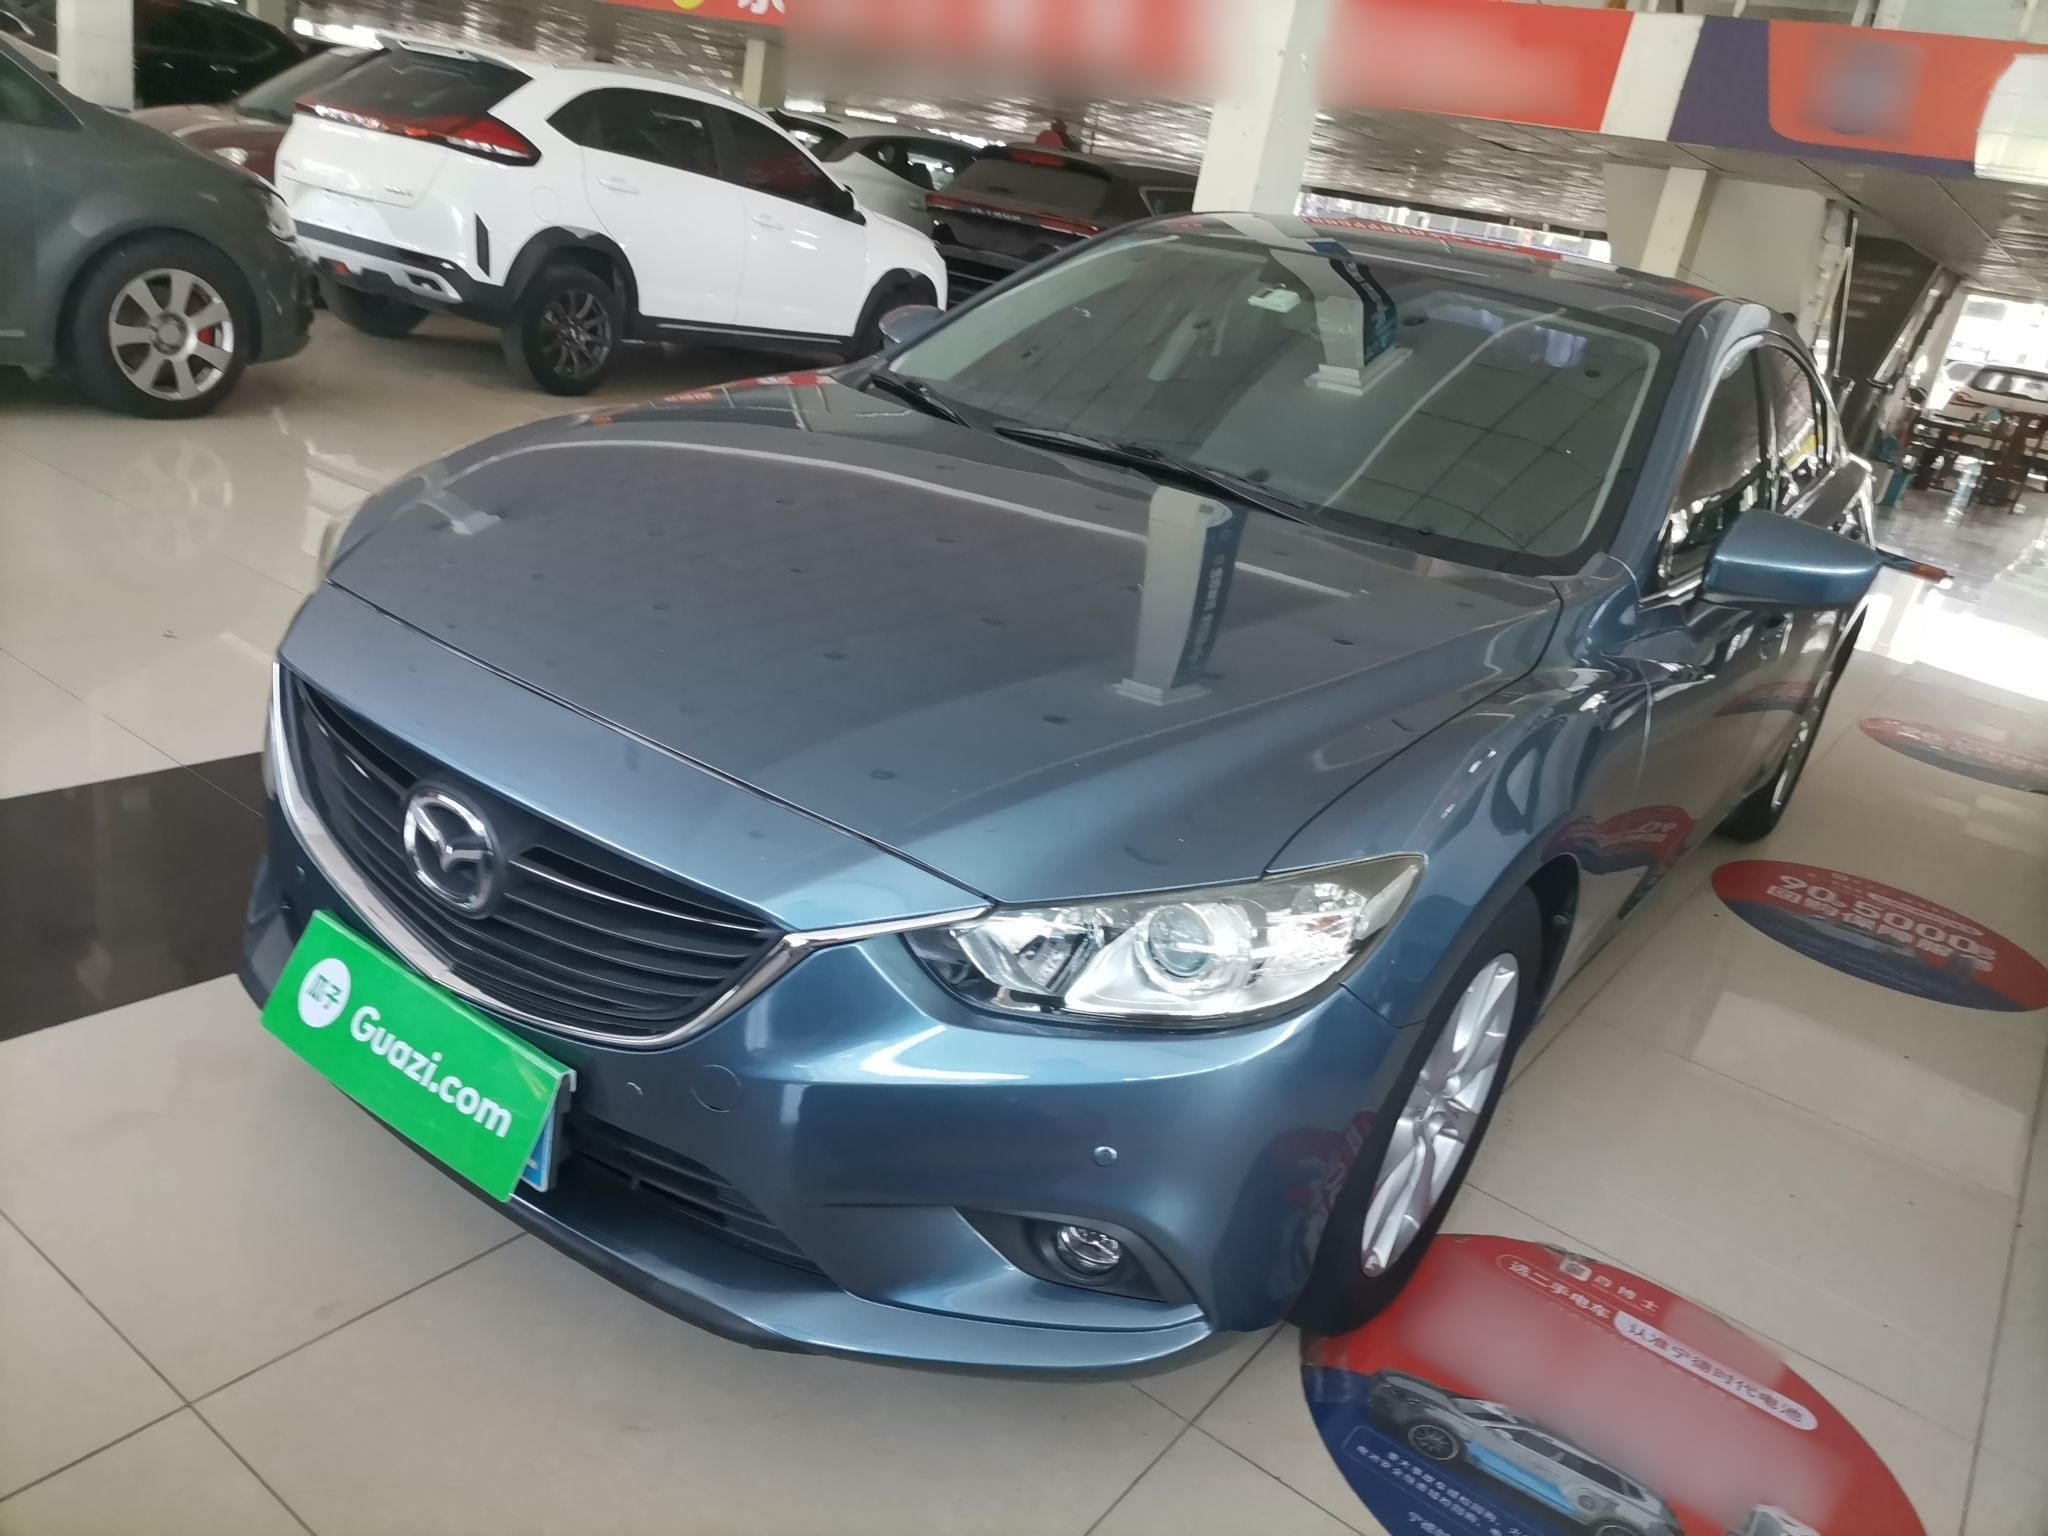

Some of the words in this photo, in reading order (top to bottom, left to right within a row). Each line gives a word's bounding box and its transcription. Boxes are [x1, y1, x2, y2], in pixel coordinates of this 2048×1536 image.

[350, 1005, 513, 1138] Guazi.com
[1628, 1323, 1803, 1423] 认准宁德时代电池
